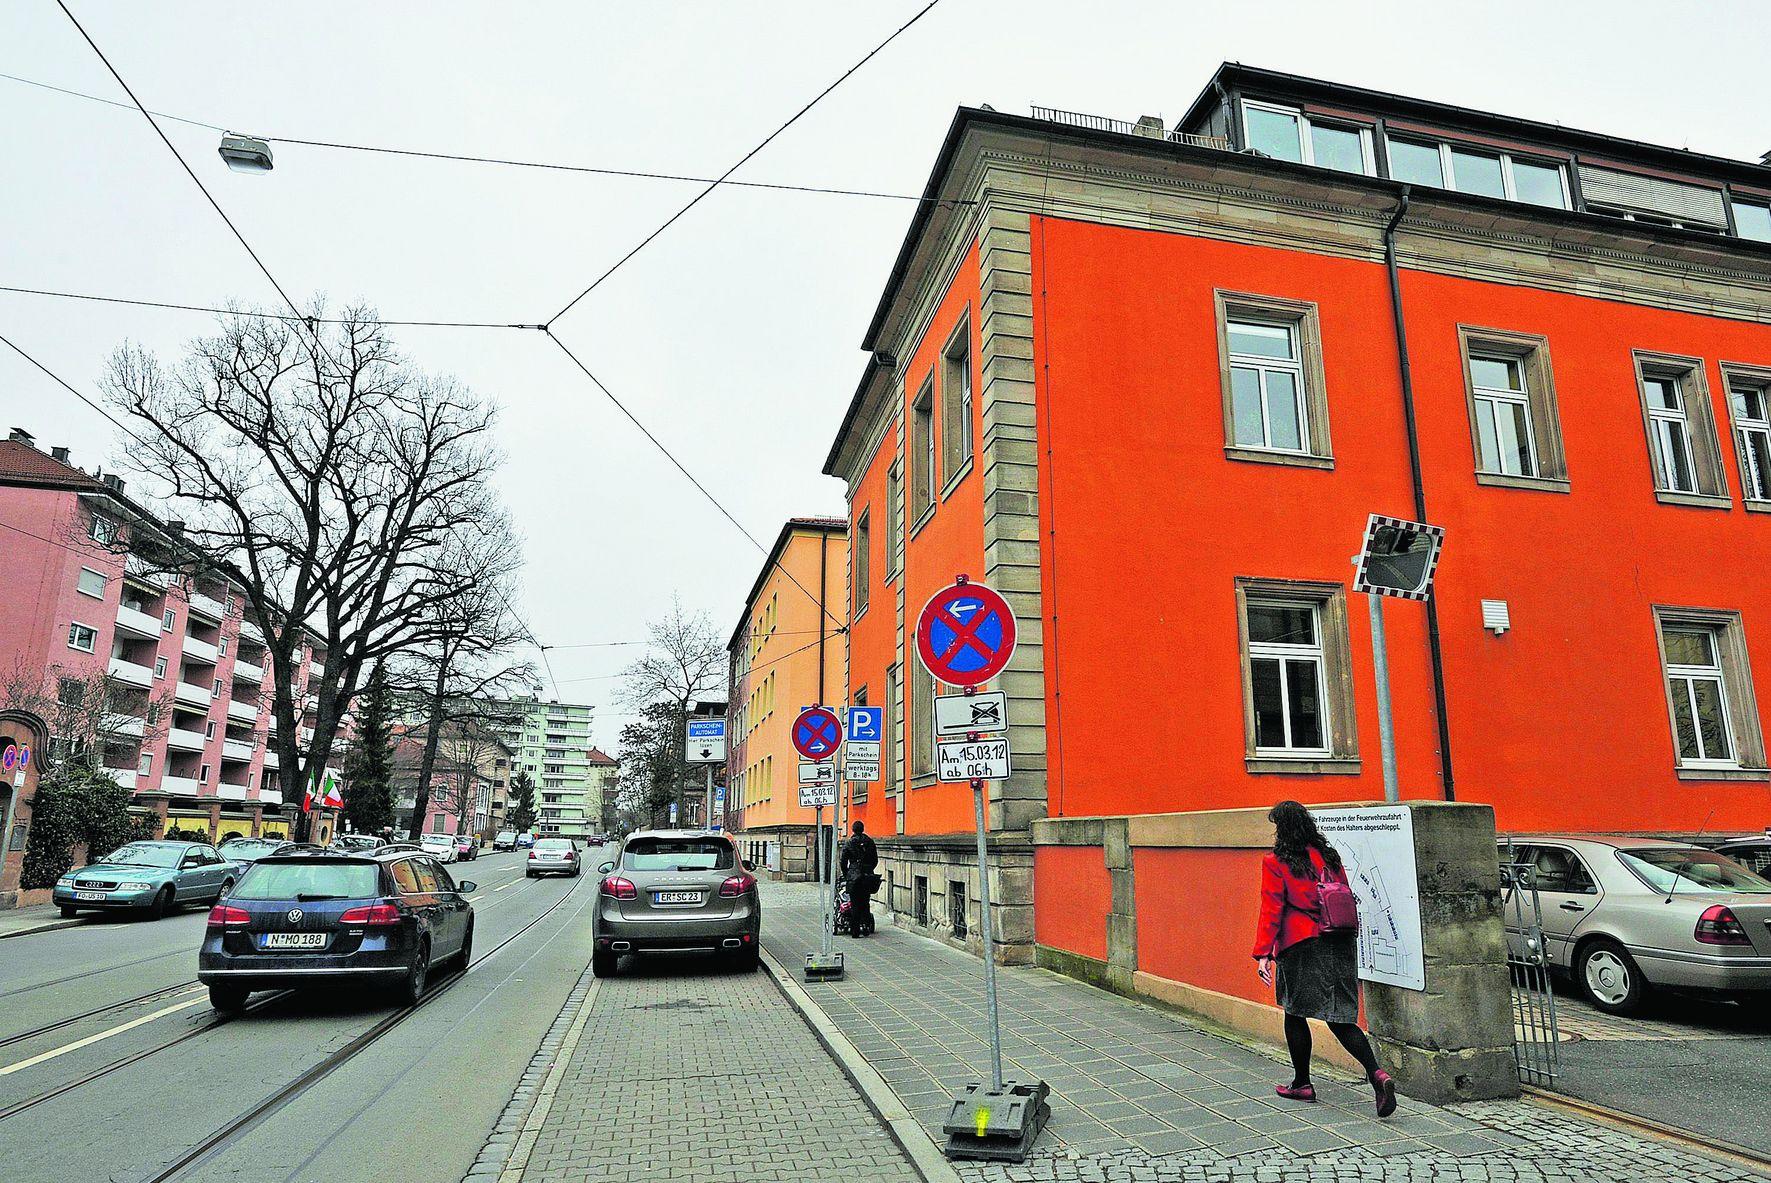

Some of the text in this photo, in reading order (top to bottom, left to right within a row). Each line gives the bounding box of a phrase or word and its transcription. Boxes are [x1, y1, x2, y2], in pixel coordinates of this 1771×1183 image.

[853, 711, 872, 737] P
[941, 744, 1005, 763] Am 15.03.12
[946, 766, 961, 777] ab
[811, 787, 834, 796] 15.03.12
[1318, 815, 1341, 823] Fahrzeuge
[1356, 813, 1402, 822] Feuerwehrzufahrt
[1364, 823, 1400, 832] abgeschleppt.
[661, 893, 672, 901] ER
[676, 893, 687, 901] SC
[271, 934, 280, 944] N
[304, 935, 322, 944] 188
